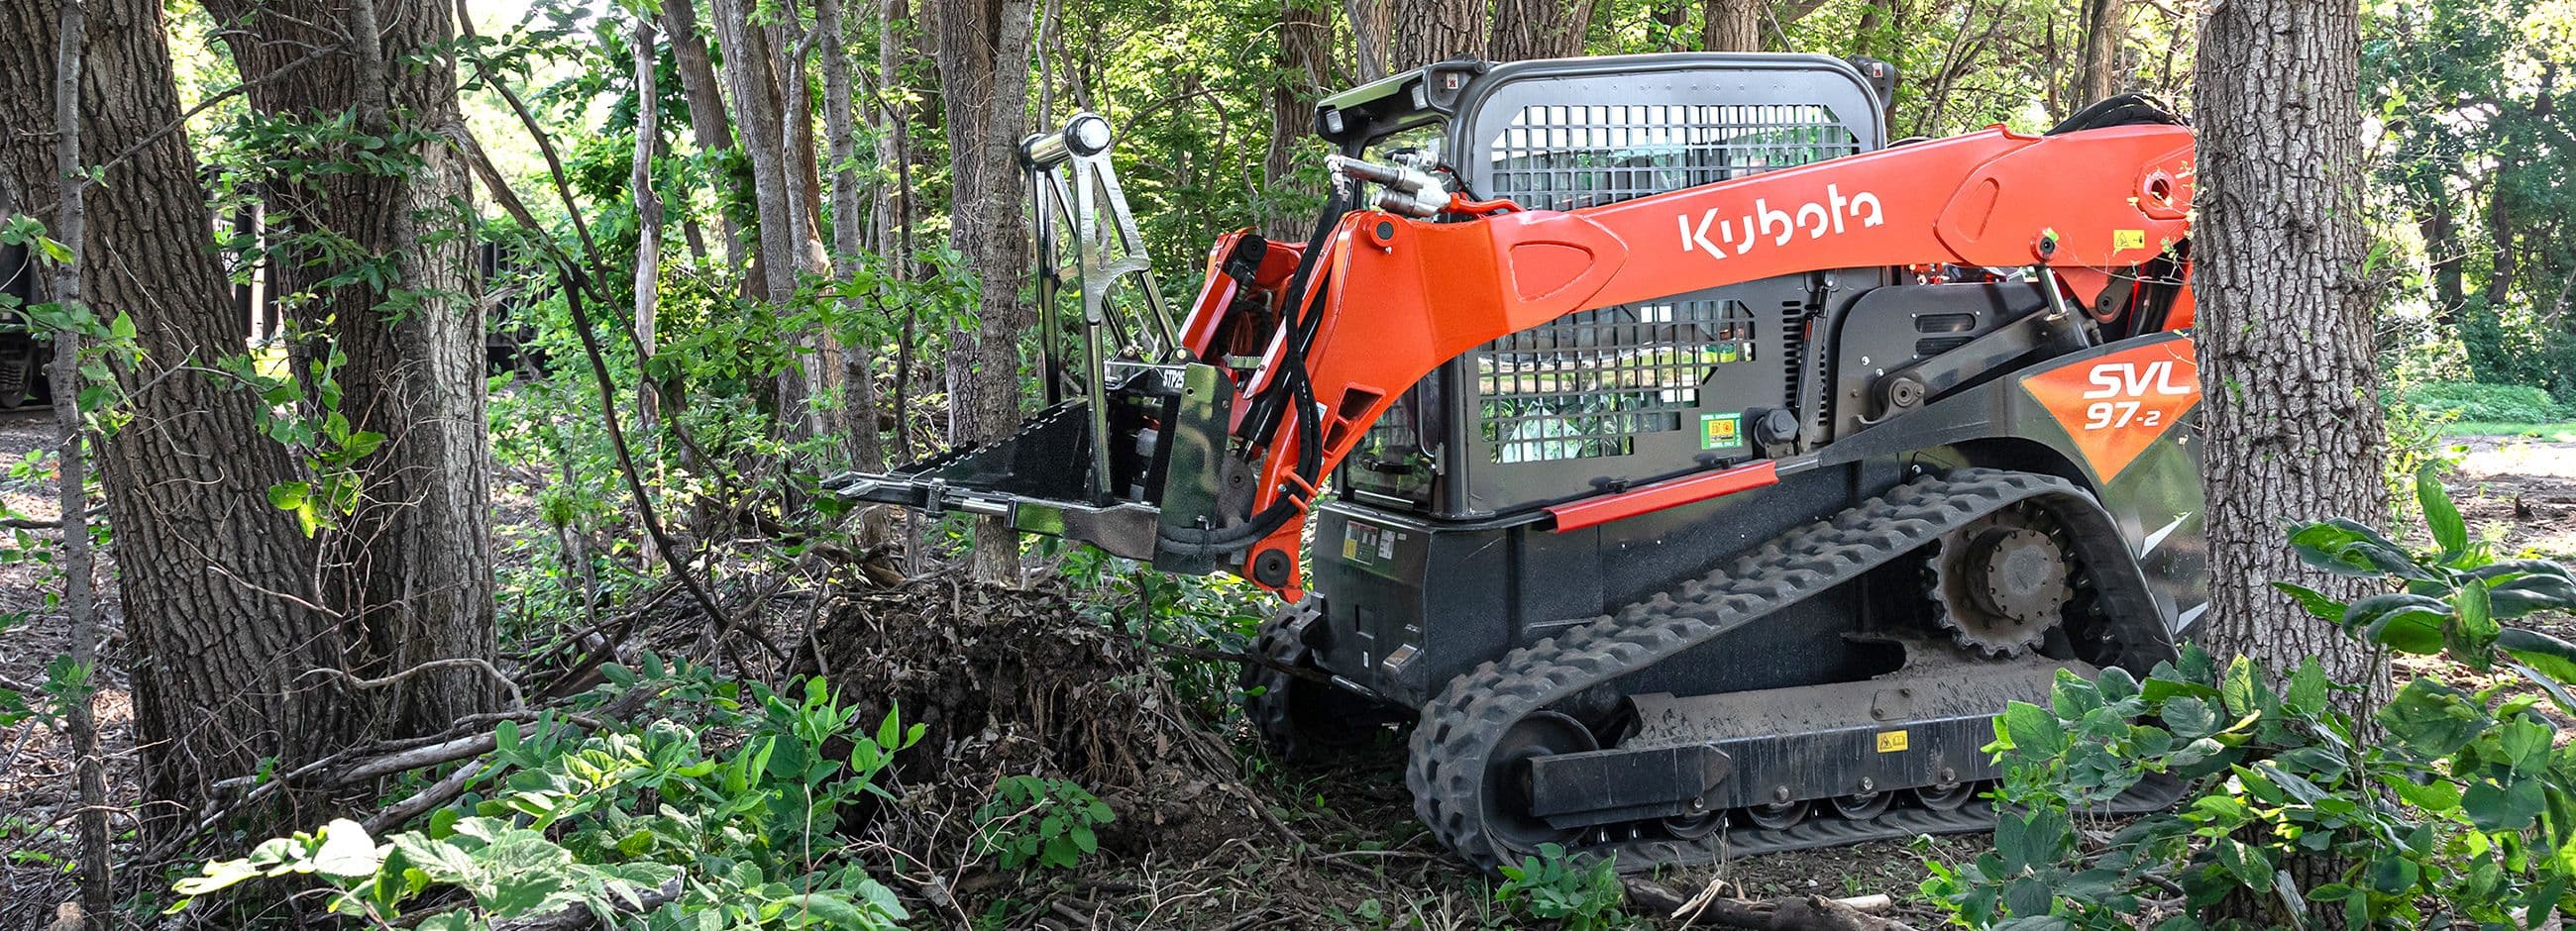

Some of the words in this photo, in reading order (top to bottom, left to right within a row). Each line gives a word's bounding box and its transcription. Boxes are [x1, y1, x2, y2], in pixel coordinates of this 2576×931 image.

[1677, 183, 1883, 259] Kubota
[2083, 361, 2191, 399] SVL
[2084, 401, 2161, 430] 97-2
